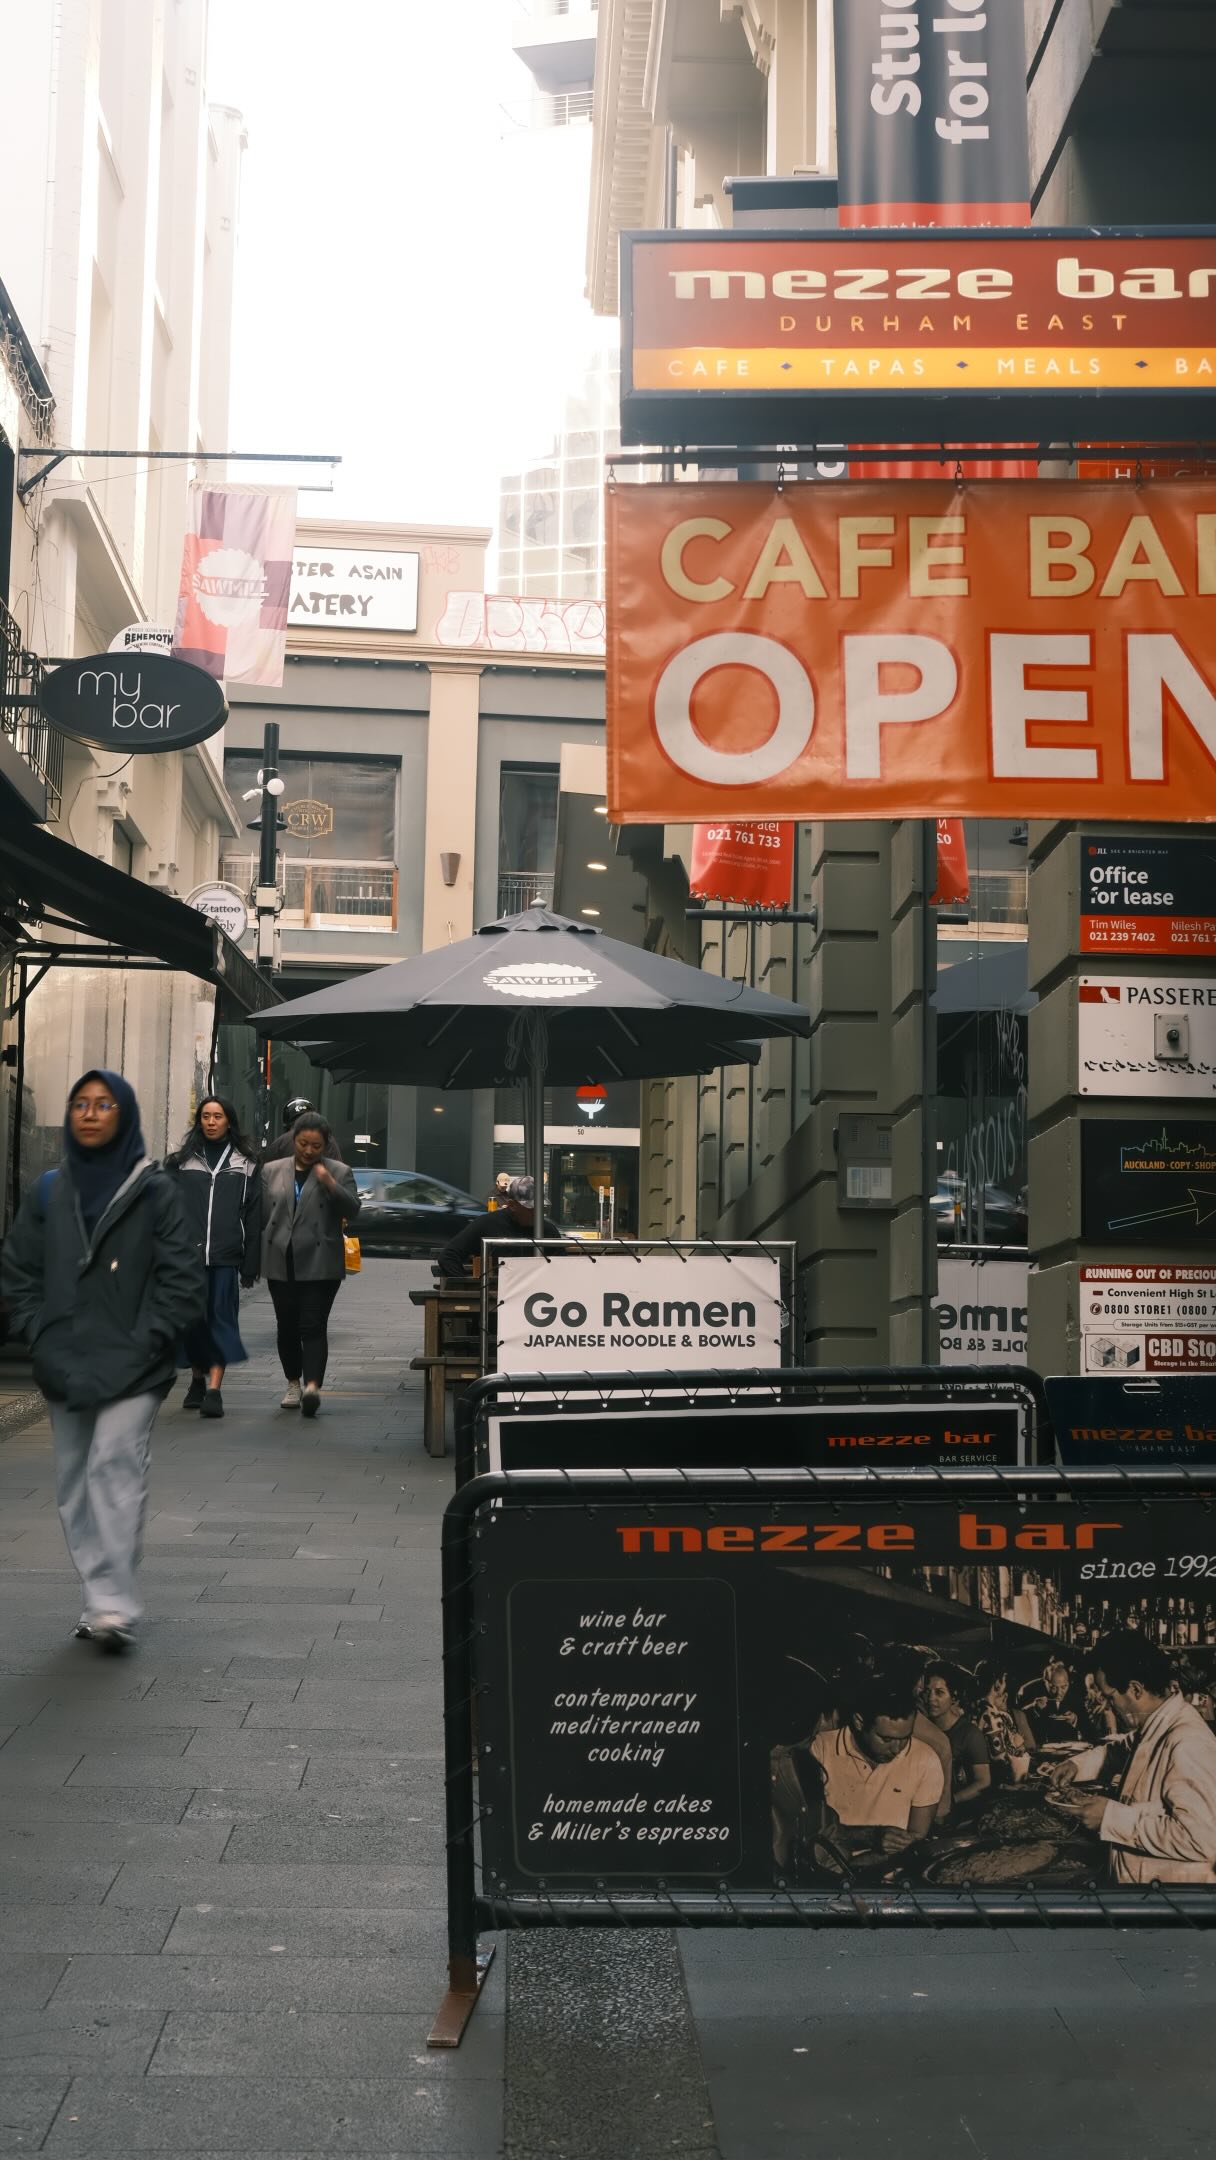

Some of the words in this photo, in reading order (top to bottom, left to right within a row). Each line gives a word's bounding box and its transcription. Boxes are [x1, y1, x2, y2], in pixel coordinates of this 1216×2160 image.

[932, 0, 987, 32] l
[870, 0, 922, 117] Stu
[934, 50, 990, 145] for
[668, 268, 1013, 300] mezze
[779, 314, 971, 332] DURHAM
[1016, 313, 1127, 331] EAST
[667, 359, 750, 376] CAFE
[821, 358, 925, 376] TAPAS
[997, 357, 1101, 375] MEALS
[660, 514, 970, 603] CAFE
[290, 561, 334, 578] TER
[348, 564, 403, 581] ASAIN
[192, 573, 269, 597] SAWMILL
[288, 591, 373, 617] ATERY
[124, 632, 174, 647] BEHEMOTH
[77, 670, 142, 705] my
[112, 697, 181, 729] bar
[653, 631, 1216, 786] OPEN
[287, 813, 327, 827] CRW
[707, 829, 732, 841] 021
[735, 830, 755, 845] 761
[758, 834, 781, 848] 733
[1089, 865, 1149, 885] Office
[1123, 887, 1174, 906] lease
[210, 904, 241, 913] tattoo
[1089, 919, 1109, 930] Tim
[1110, 920, 1137, 930] Wiles
[1171, 921, 1202, 931] Nilesh
[1089, 931, 1108, 941] 021
[1110, 932, 1129, 941] 239
[1131, 932, 1156, 942] 7402
[1171, 933, 1189, 943] 021
[1192, 934, 1211, 943] 761
[482, 976, 603, 985] SAWMILL
[1126, 986, 1216, 1007] PASSERE
[1124, 1160, 1166, 1170] AUCKLAND
[1169, 1160, 1191, 1170] COPY
[1195, 1161, 1216, 1171] SHOP
[1085, 1268, 1133, 1280] RUNNING
[1135, 1269, 1156, 1280] OUT
[1159, 1269, 1172, 1280] OF
[1107, 1288, 1166, 1298] Convenient
[1169, 1288, 1194, 1300] High
[1197, 1289, 1207, 1298] St
[523, 1291, 588, 1328] Go
[602, 1292, 756, 1328] Ramen
[1104, 1304, 1130, 1315] 0800
[1134, 1304, 1171, 1315] STORE1
[1176, 1304, 1207, 1317] (0800
[1121, 1321, 1143, 1329] Storage
[523, 1334, 606, 1348] JAPANESE
[610, 1334, 677, 1348] NOODLE
[681, 1334, 693, 1348] &
[698, 1334, 756, 1348] BOWLS
[1148, 1337, 1184, 1357] CBD
[1187, 1338, 1216, 1358] Sto
[1153, 1360, 1178, 1368] Storage
[826, 1434, 931, 1448] mezze
[943, 1430, 998, 1445] bar
[1069, 1426, 1174, 1441] mezze
[939, 1455, 957, 1463] BAR
[960, 1454, 998, 1463] SERVICE
[616, 1523, 914, 1553] mezze
[958, 1513, 1123, 1551] bar
[1080, 1557, 1157, 1580] since
[1163, 1554, 1216, 1579] 1992
[579, 1609, 626, 1628] wine
[632, 1606, 667, 1628] bar
[559, 1636, 576, 1656] &
[581, 1635, 639, 1656] craft
[641, 1634, 689, 1656] beer
[553, 1687, 698, 1711] contemporary
[549, 1714, 702, 1735] mediterranean
[587, 1742, 666, 1768] cooking
[542, 1792, 648, 1814] homemade
[653, 1793, 713, 1814] cakes
[527, 1821, 544, 1841] &
[550, 1820, 631, 1841] Miller's
[636, 1824, 730, 1845] espresso
